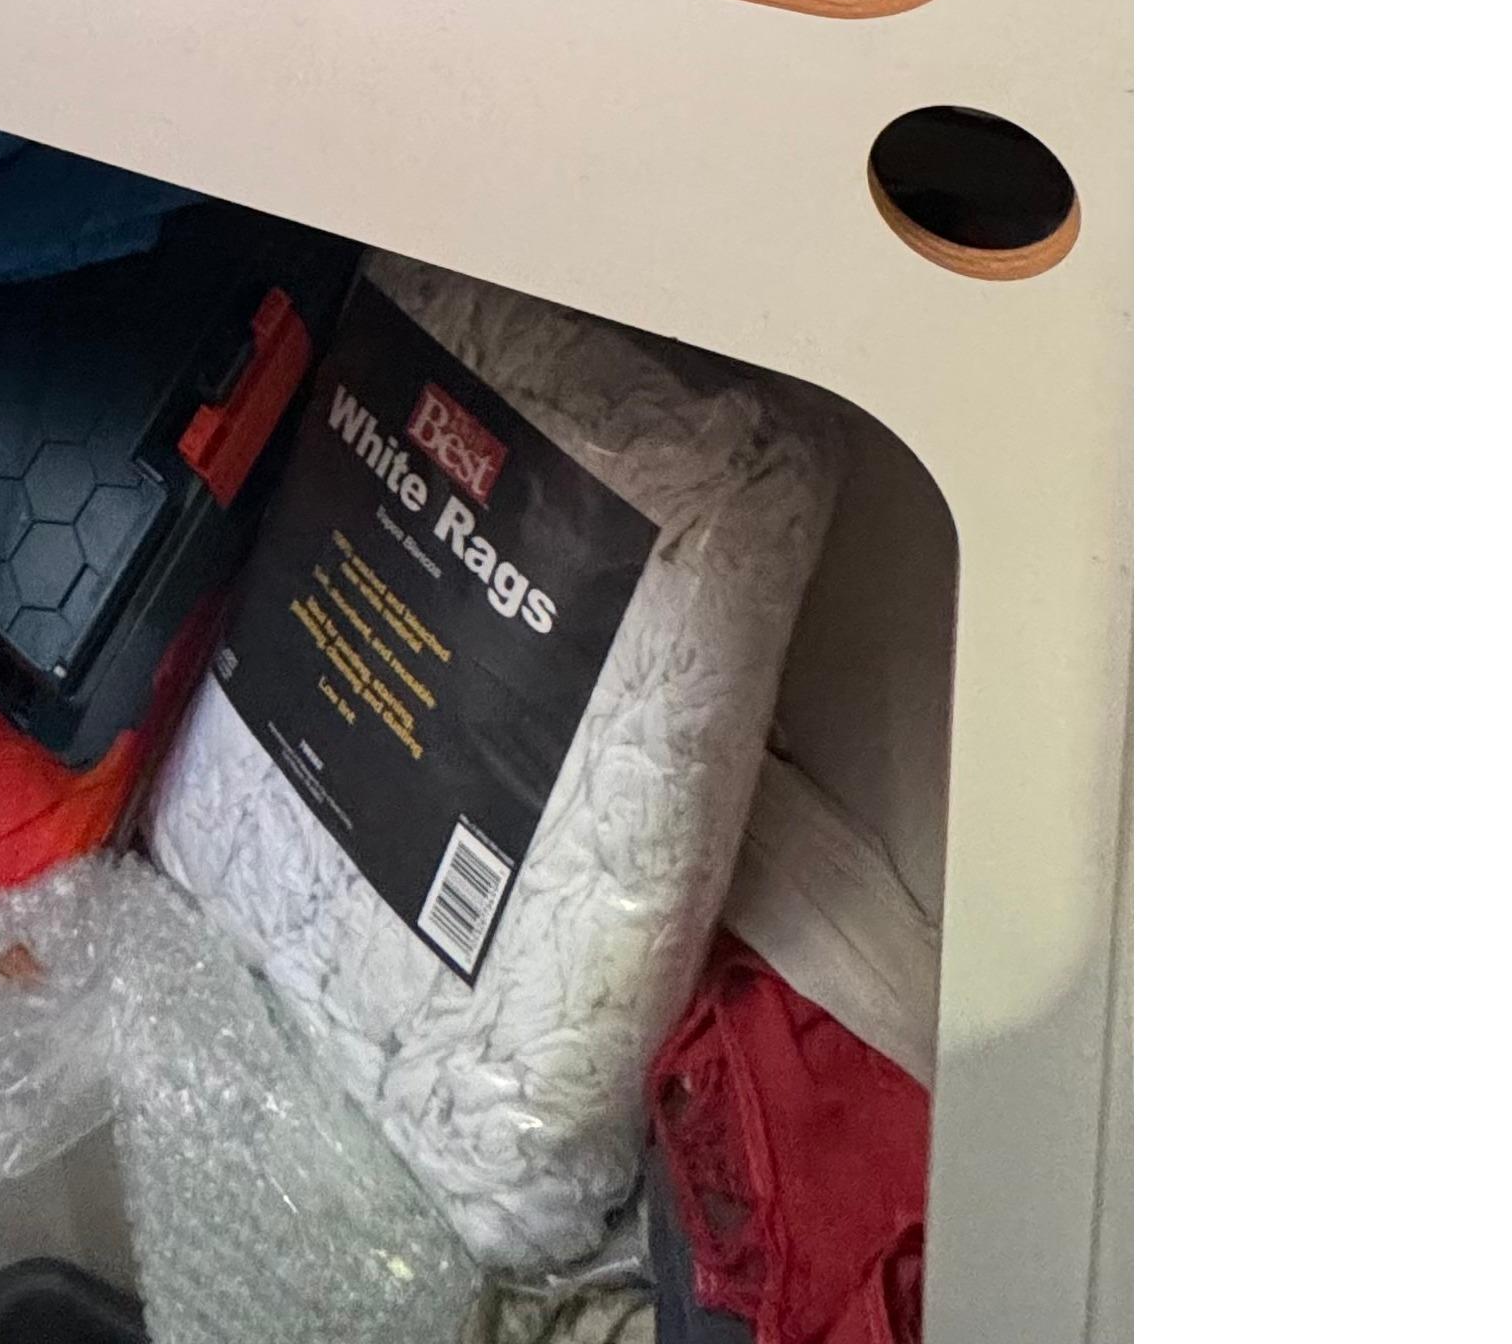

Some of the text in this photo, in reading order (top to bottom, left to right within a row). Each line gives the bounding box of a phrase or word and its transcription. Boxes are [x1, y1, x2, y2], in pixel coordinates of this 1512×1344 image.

[327, 385, 559, 634] White Rags
[408, 392, 497, 497] Best
